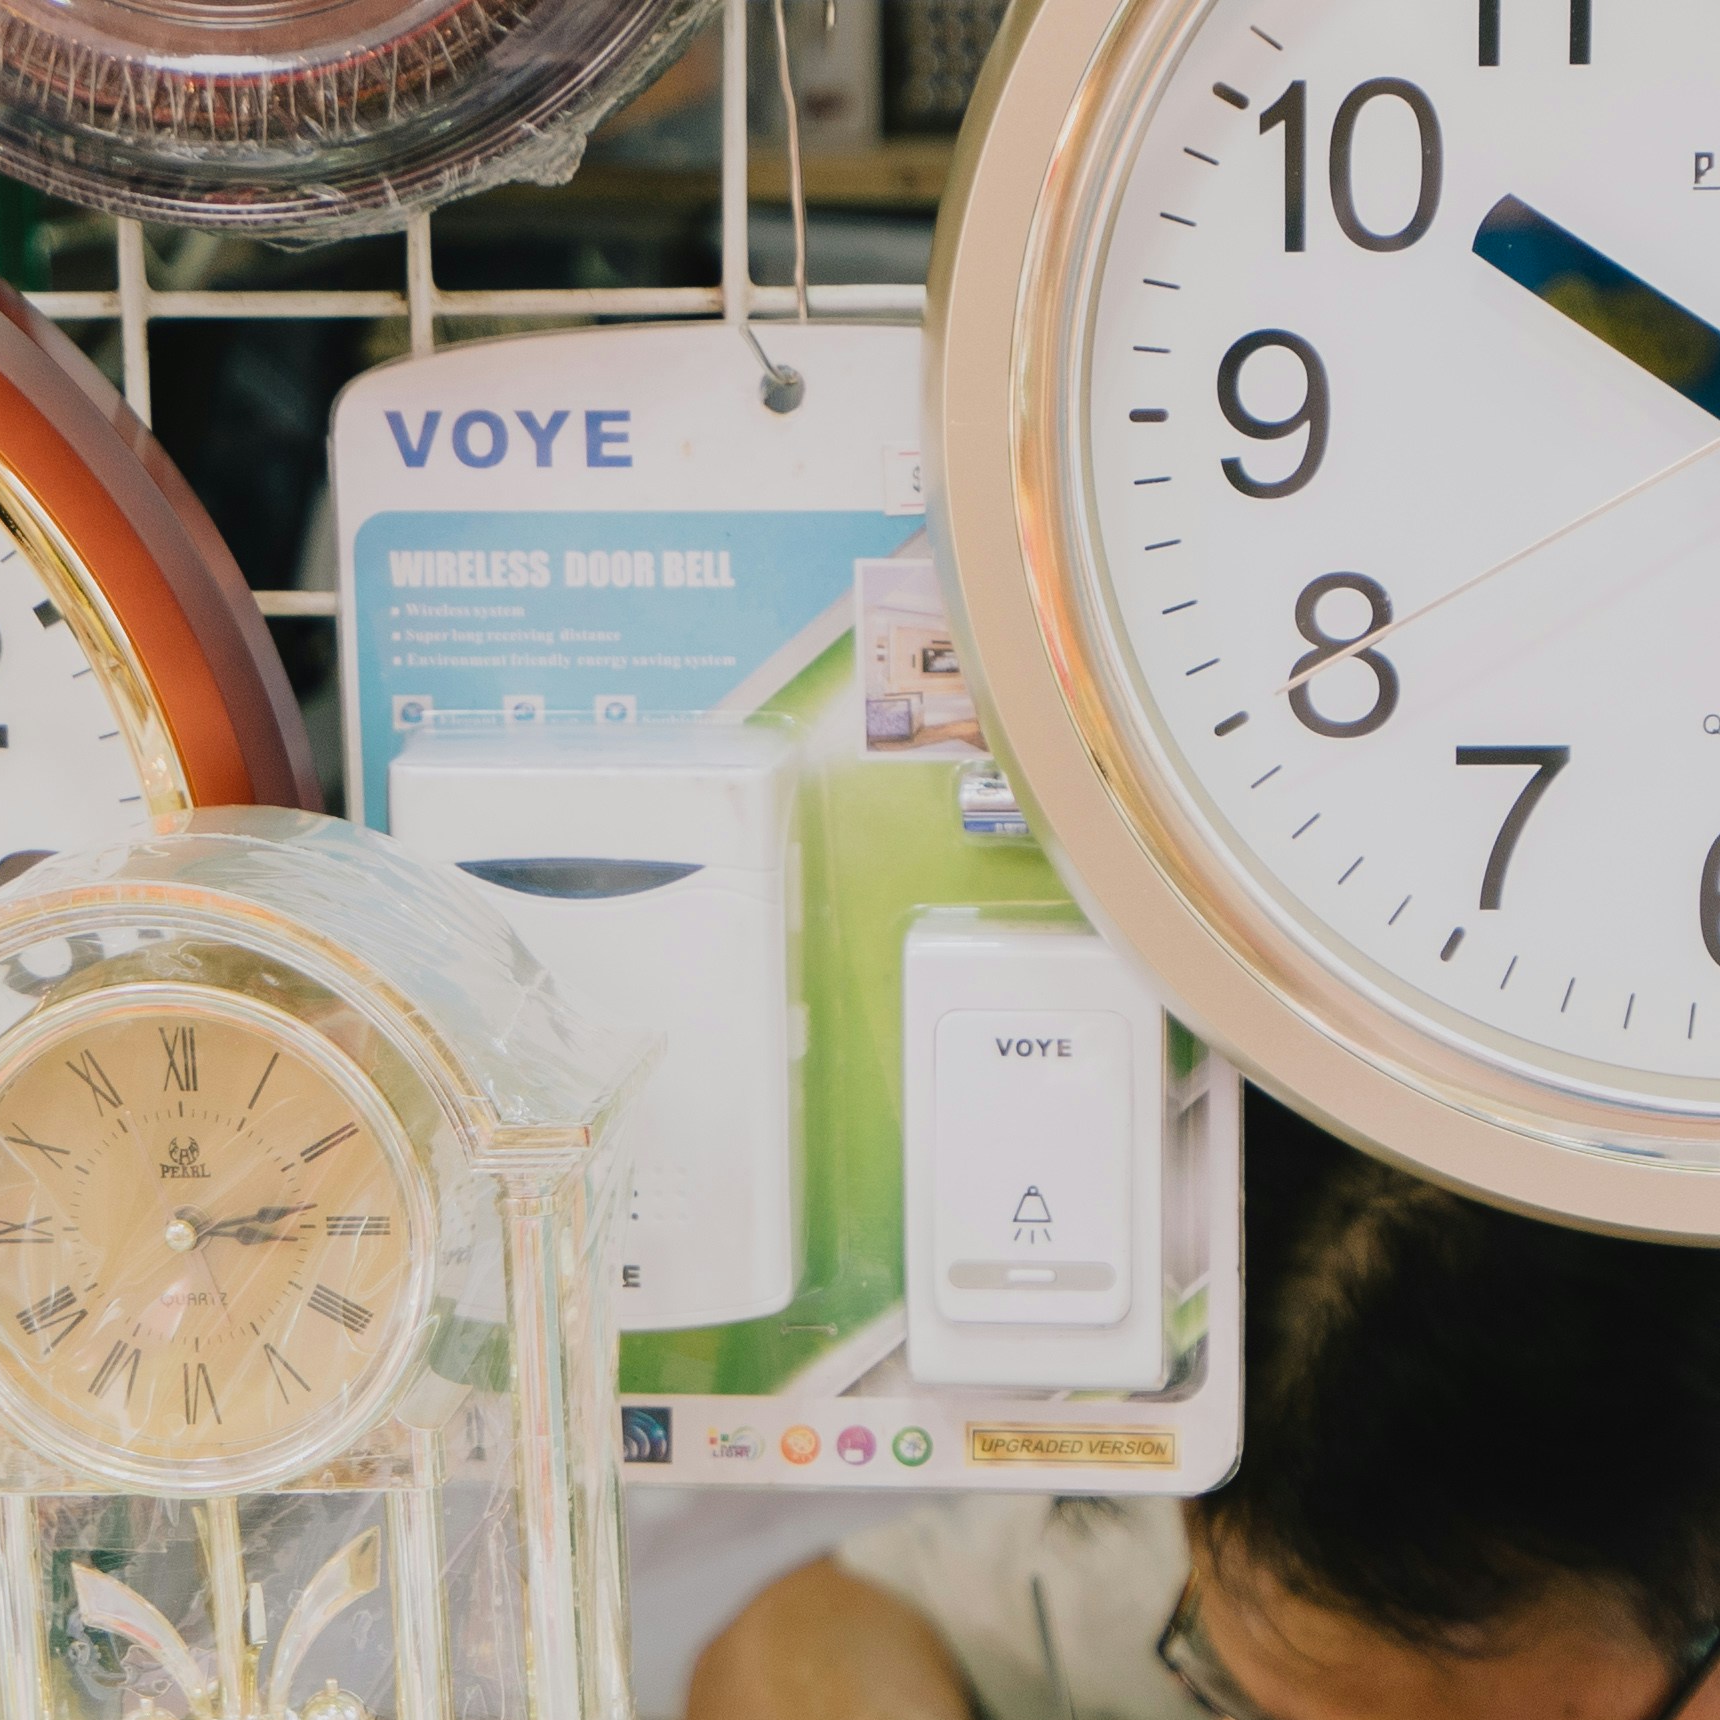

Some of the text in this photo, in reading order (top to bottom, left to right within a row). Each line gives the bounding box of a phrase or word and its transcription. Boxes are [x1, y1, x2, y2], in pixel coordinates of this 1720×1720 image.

[1257, 75, 1444, 254] 10
[1216, 327, 1331, 501] 9
[383, 409, 633, 469] VOYE
[389, 550, 736, 588] WIRELESS DOOR BELL
[404, 603, 474, 618] Wireless
[406, 629, 449, 643] Super
[486, 629, 554, 644] receiving
[561, 629, 621, 642] distance
[1287, 571, 1401, 738] 8
[1453, 745, 1572, 912] 7
[158, 1027, 197, 1091] XII
[996, 1038, 1074, 1059] VOYE
[160, 1164, 210, 1179] PEARL
[161, 1291, 227, 1306] QUARTZ
[980, 1437, 1168, 1458] UPGRADED VERSION
